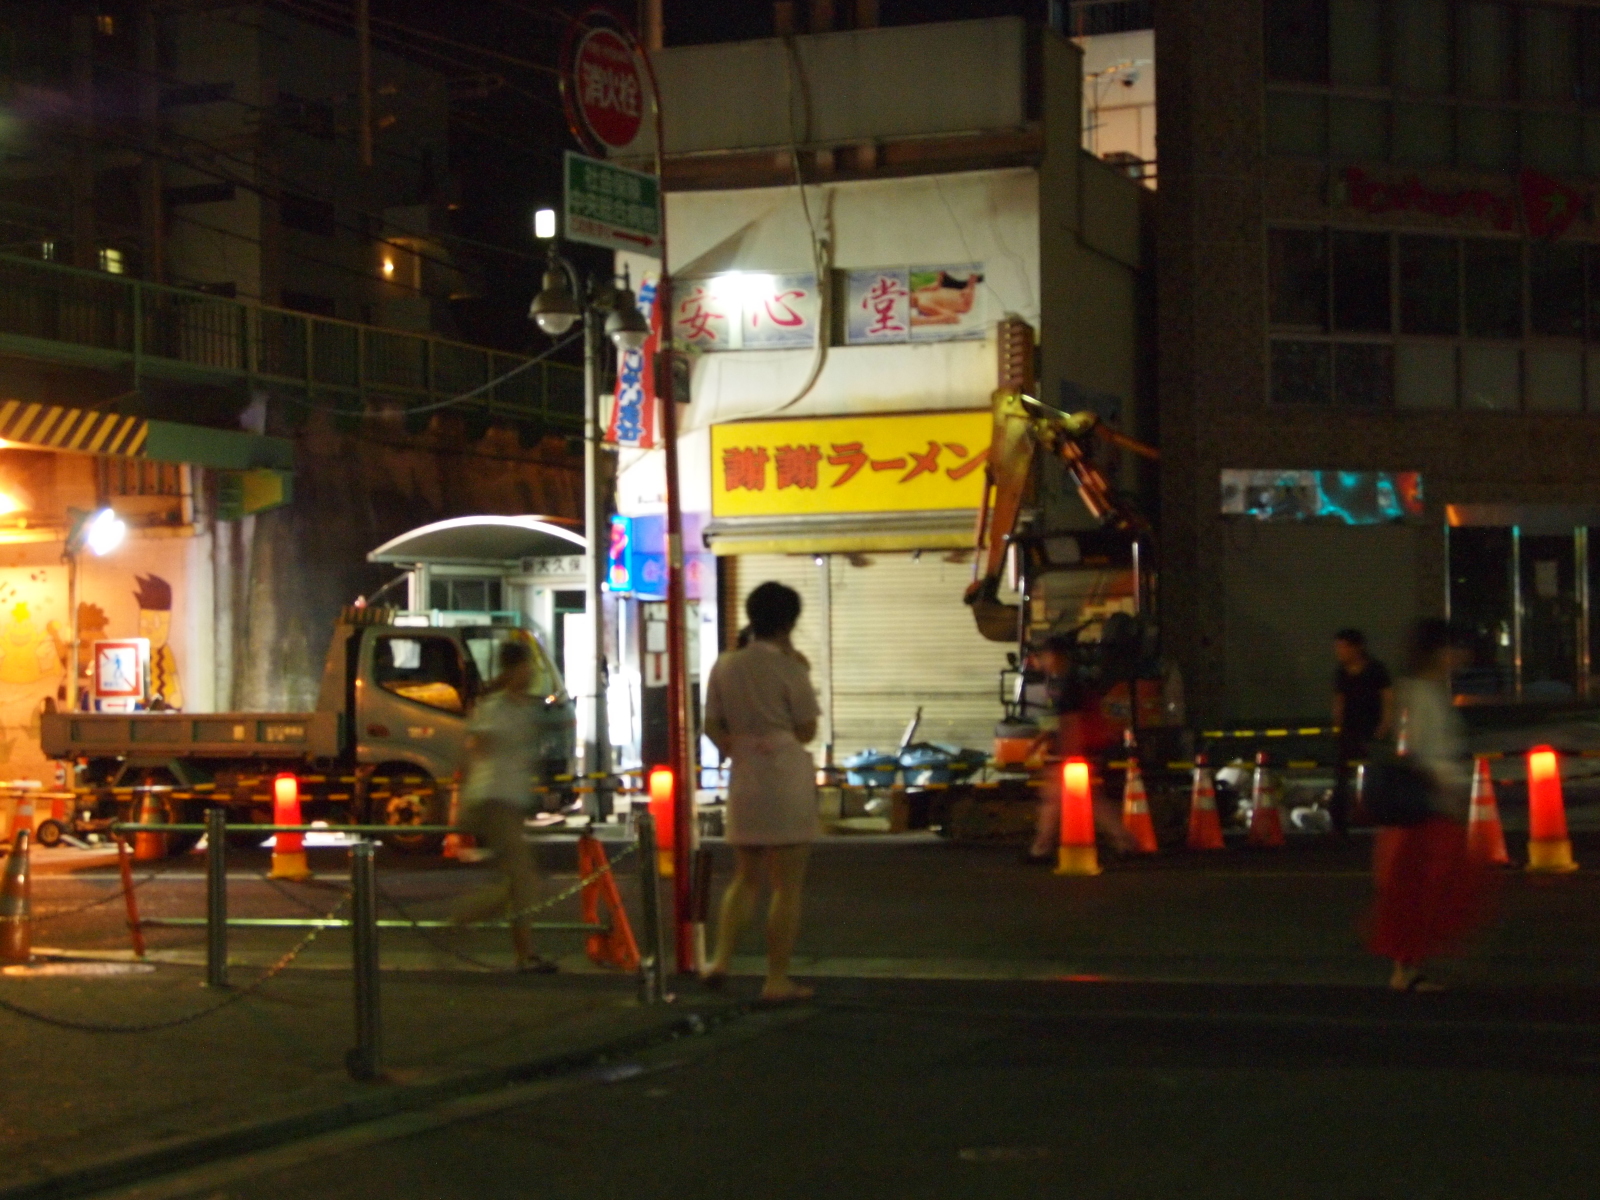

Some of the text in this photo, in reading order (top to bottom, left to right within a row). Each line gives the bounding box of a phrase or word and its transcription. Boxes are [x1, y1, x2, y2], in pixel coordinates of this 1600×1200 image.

[723, 440, 991, 492] 謝謝ラーメン
